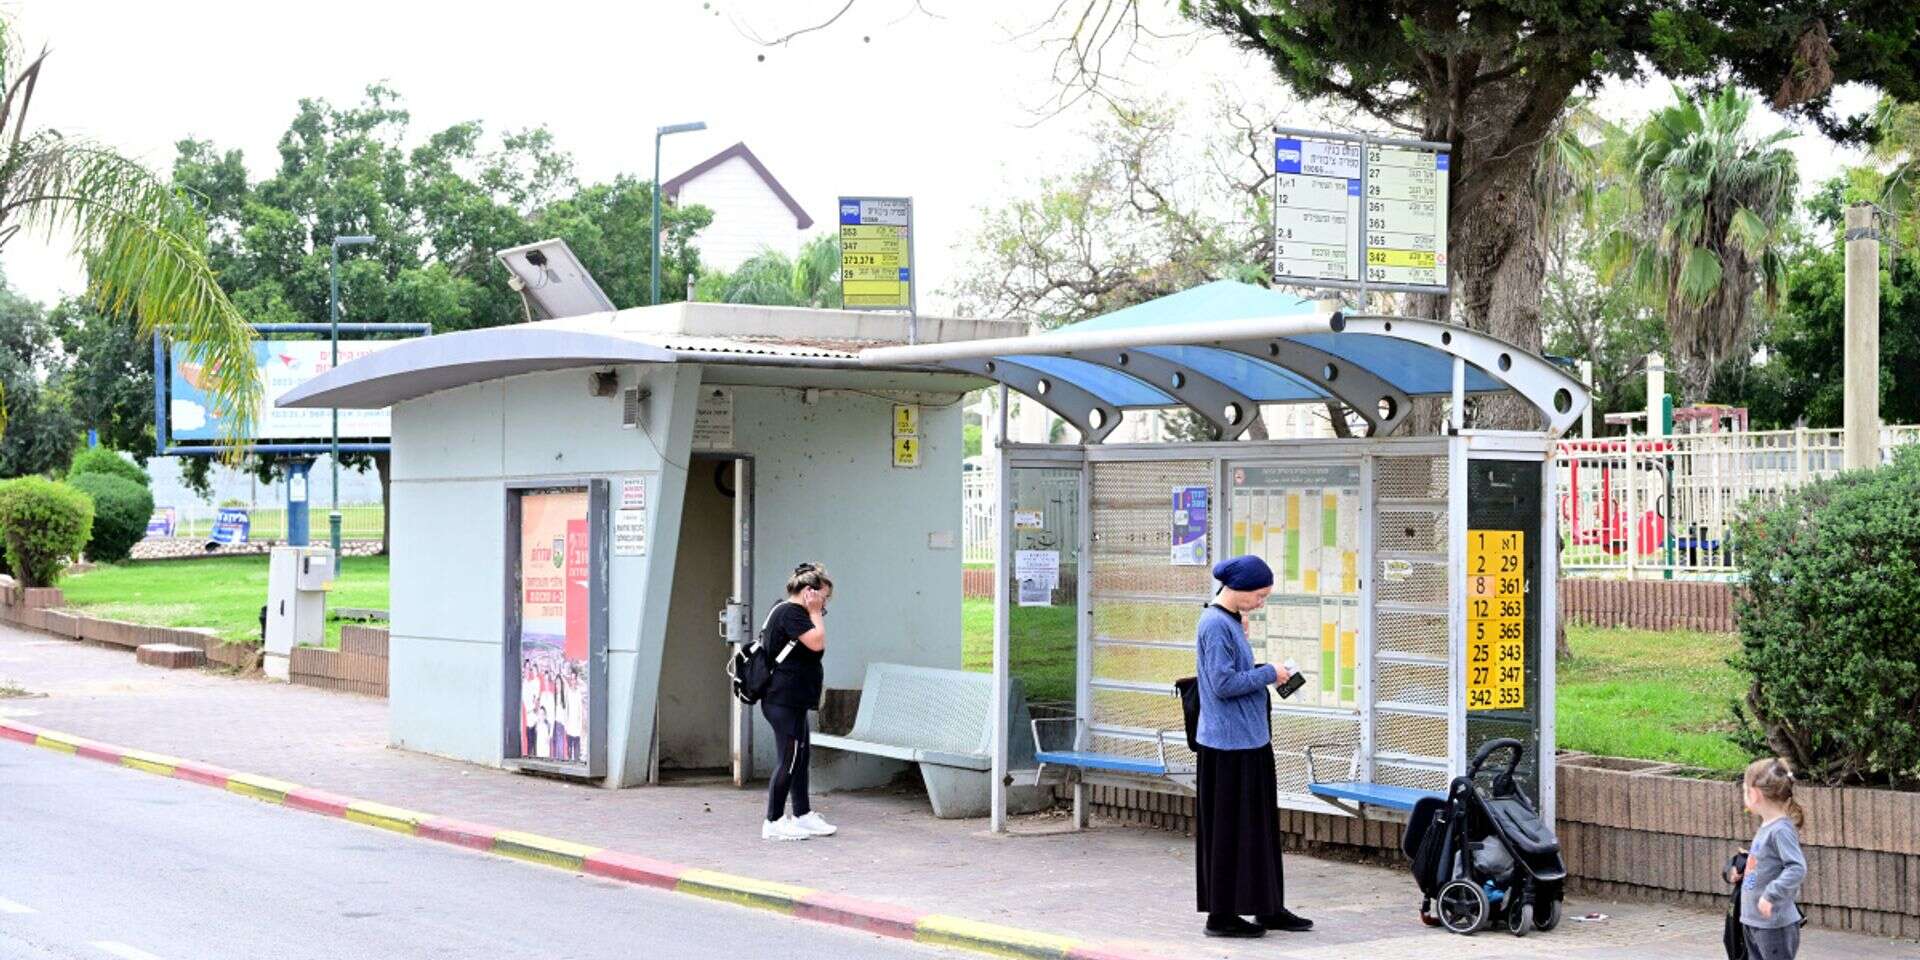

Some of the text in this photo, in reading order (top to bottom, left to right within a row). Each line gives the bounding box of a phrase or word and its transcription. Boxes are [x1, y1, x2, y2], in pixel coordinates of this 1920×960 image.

[1369, 152, 1381, 162] 25
[1369, 168, 1381, 178] 27
[1369, 185, 1381, 195] 29
[1278, 194, 1288, 203] 12
[1369, 202, 1385, 212] 361
[1369, 219, 1385, 229] 363
[843, 242, 858, 250] 347
[1369, 236, 1386, 246] 365
[1278, 246, 1284, 255] 5
[1369, 252, 1386, 262] 342
[844, 269, 854, 279] 29
[1278, 263, 1284, 272] 8
[1369, 268, 1386, 279] 343
[903, 409, 910, 421] 1
[903, 439, 910, 452] 4
[1477, 533, 1486, 550] 1
[1476, 556, 1486, 573] 2
[1500, 555, 1518, 572] 29
[1476, 577, 1486, 594] 8
[1499, 578, 1521, 595] 361
[1473, 600, 1489, 617] 12
[1499, 601, 1521, 617] 363
[1476, 623, 1485, 640] 5
[1499, 623, 1521, 640] 365
[1473, 645, 1489, 662] 25
[1499, 645, 1521, 662] 343
[1473, 667, 1489, 685] 27
[1499, 666, 1521, 683] 347
[1470, 690, 1493, 707] 342
[1499, 687, 1521, 704] 353
